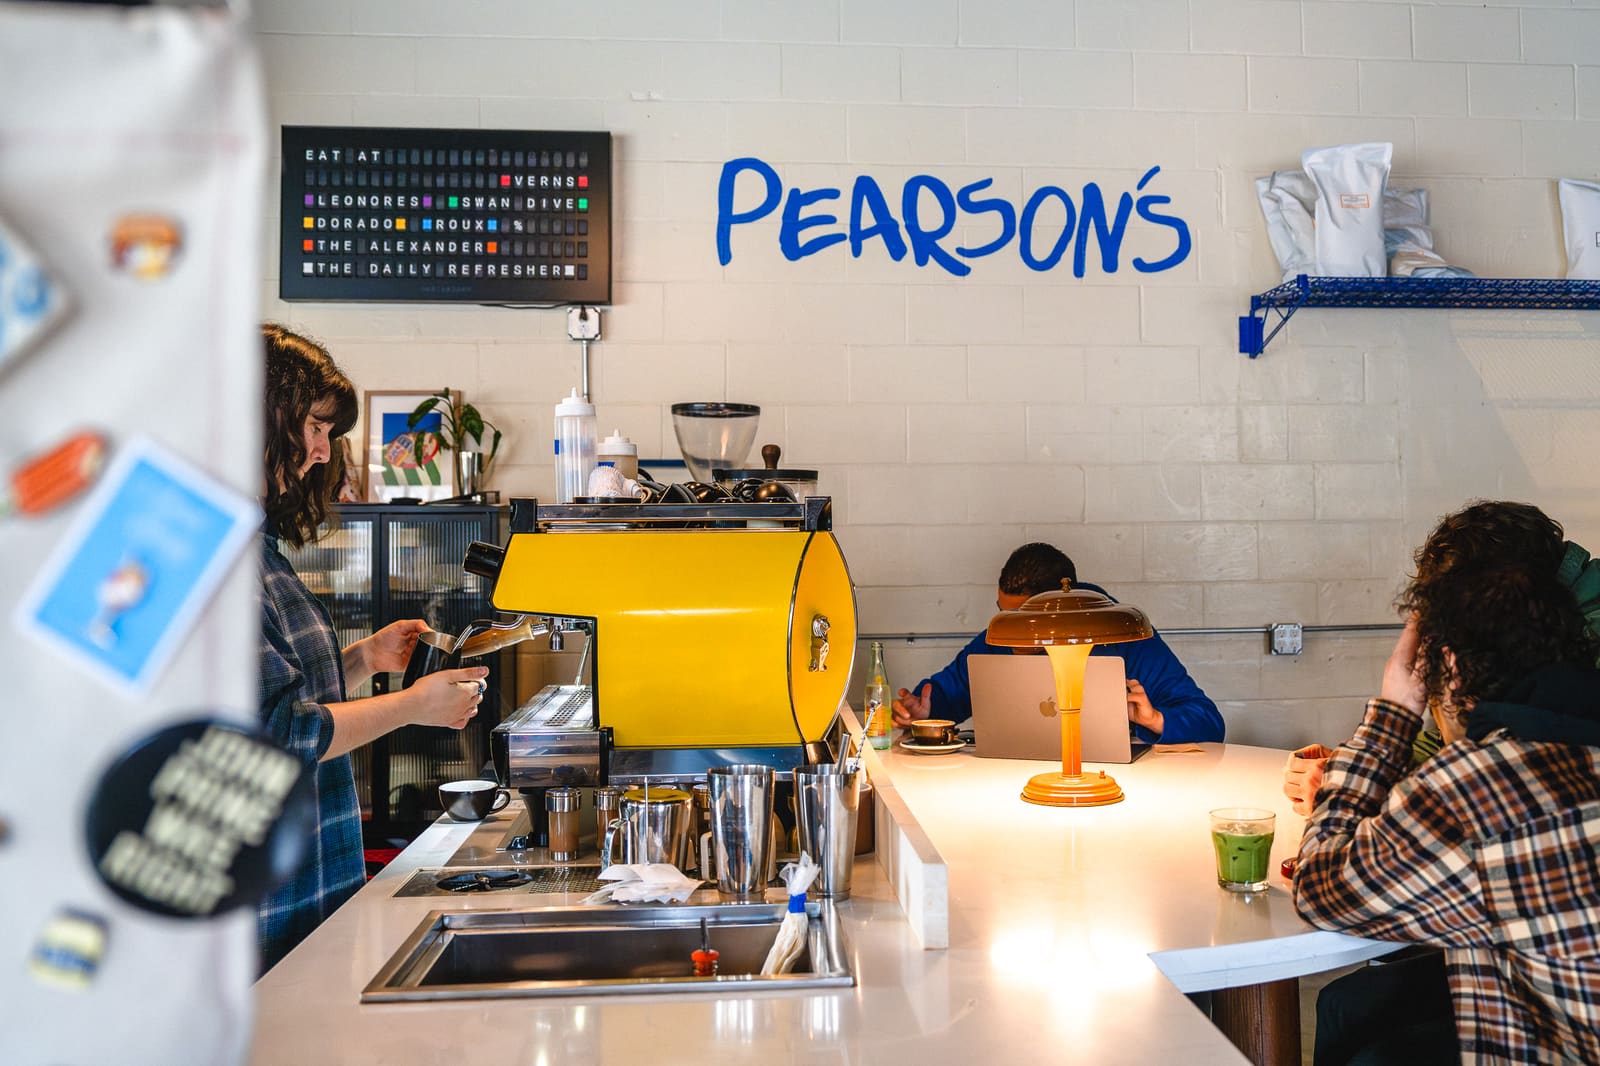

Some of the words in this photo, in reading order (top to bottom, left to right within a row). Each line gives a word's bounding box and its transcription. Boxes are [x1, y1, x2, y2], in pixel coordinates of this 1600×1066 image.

[305, 149, 341, 161] EAT
[357, 150, 381, 161] AT
[514, 175, 575, 187] VERNS
[318, 195, 419, 207] LEONORES
[462, 196, 511, 208] SWAN
[526, 197, 574, 209] DIVE
[317, 217, 393, 230] DORADO
[435, 219, 484, 231] ROUX
[317, 240, 352, 252] THE
[369, 240, 484, 253] ALEXANDER
[317, 263, 352, 274] THE
[369, 263, 431, 275] DAILY
[448, 263, 561, 276] REFRESHER
